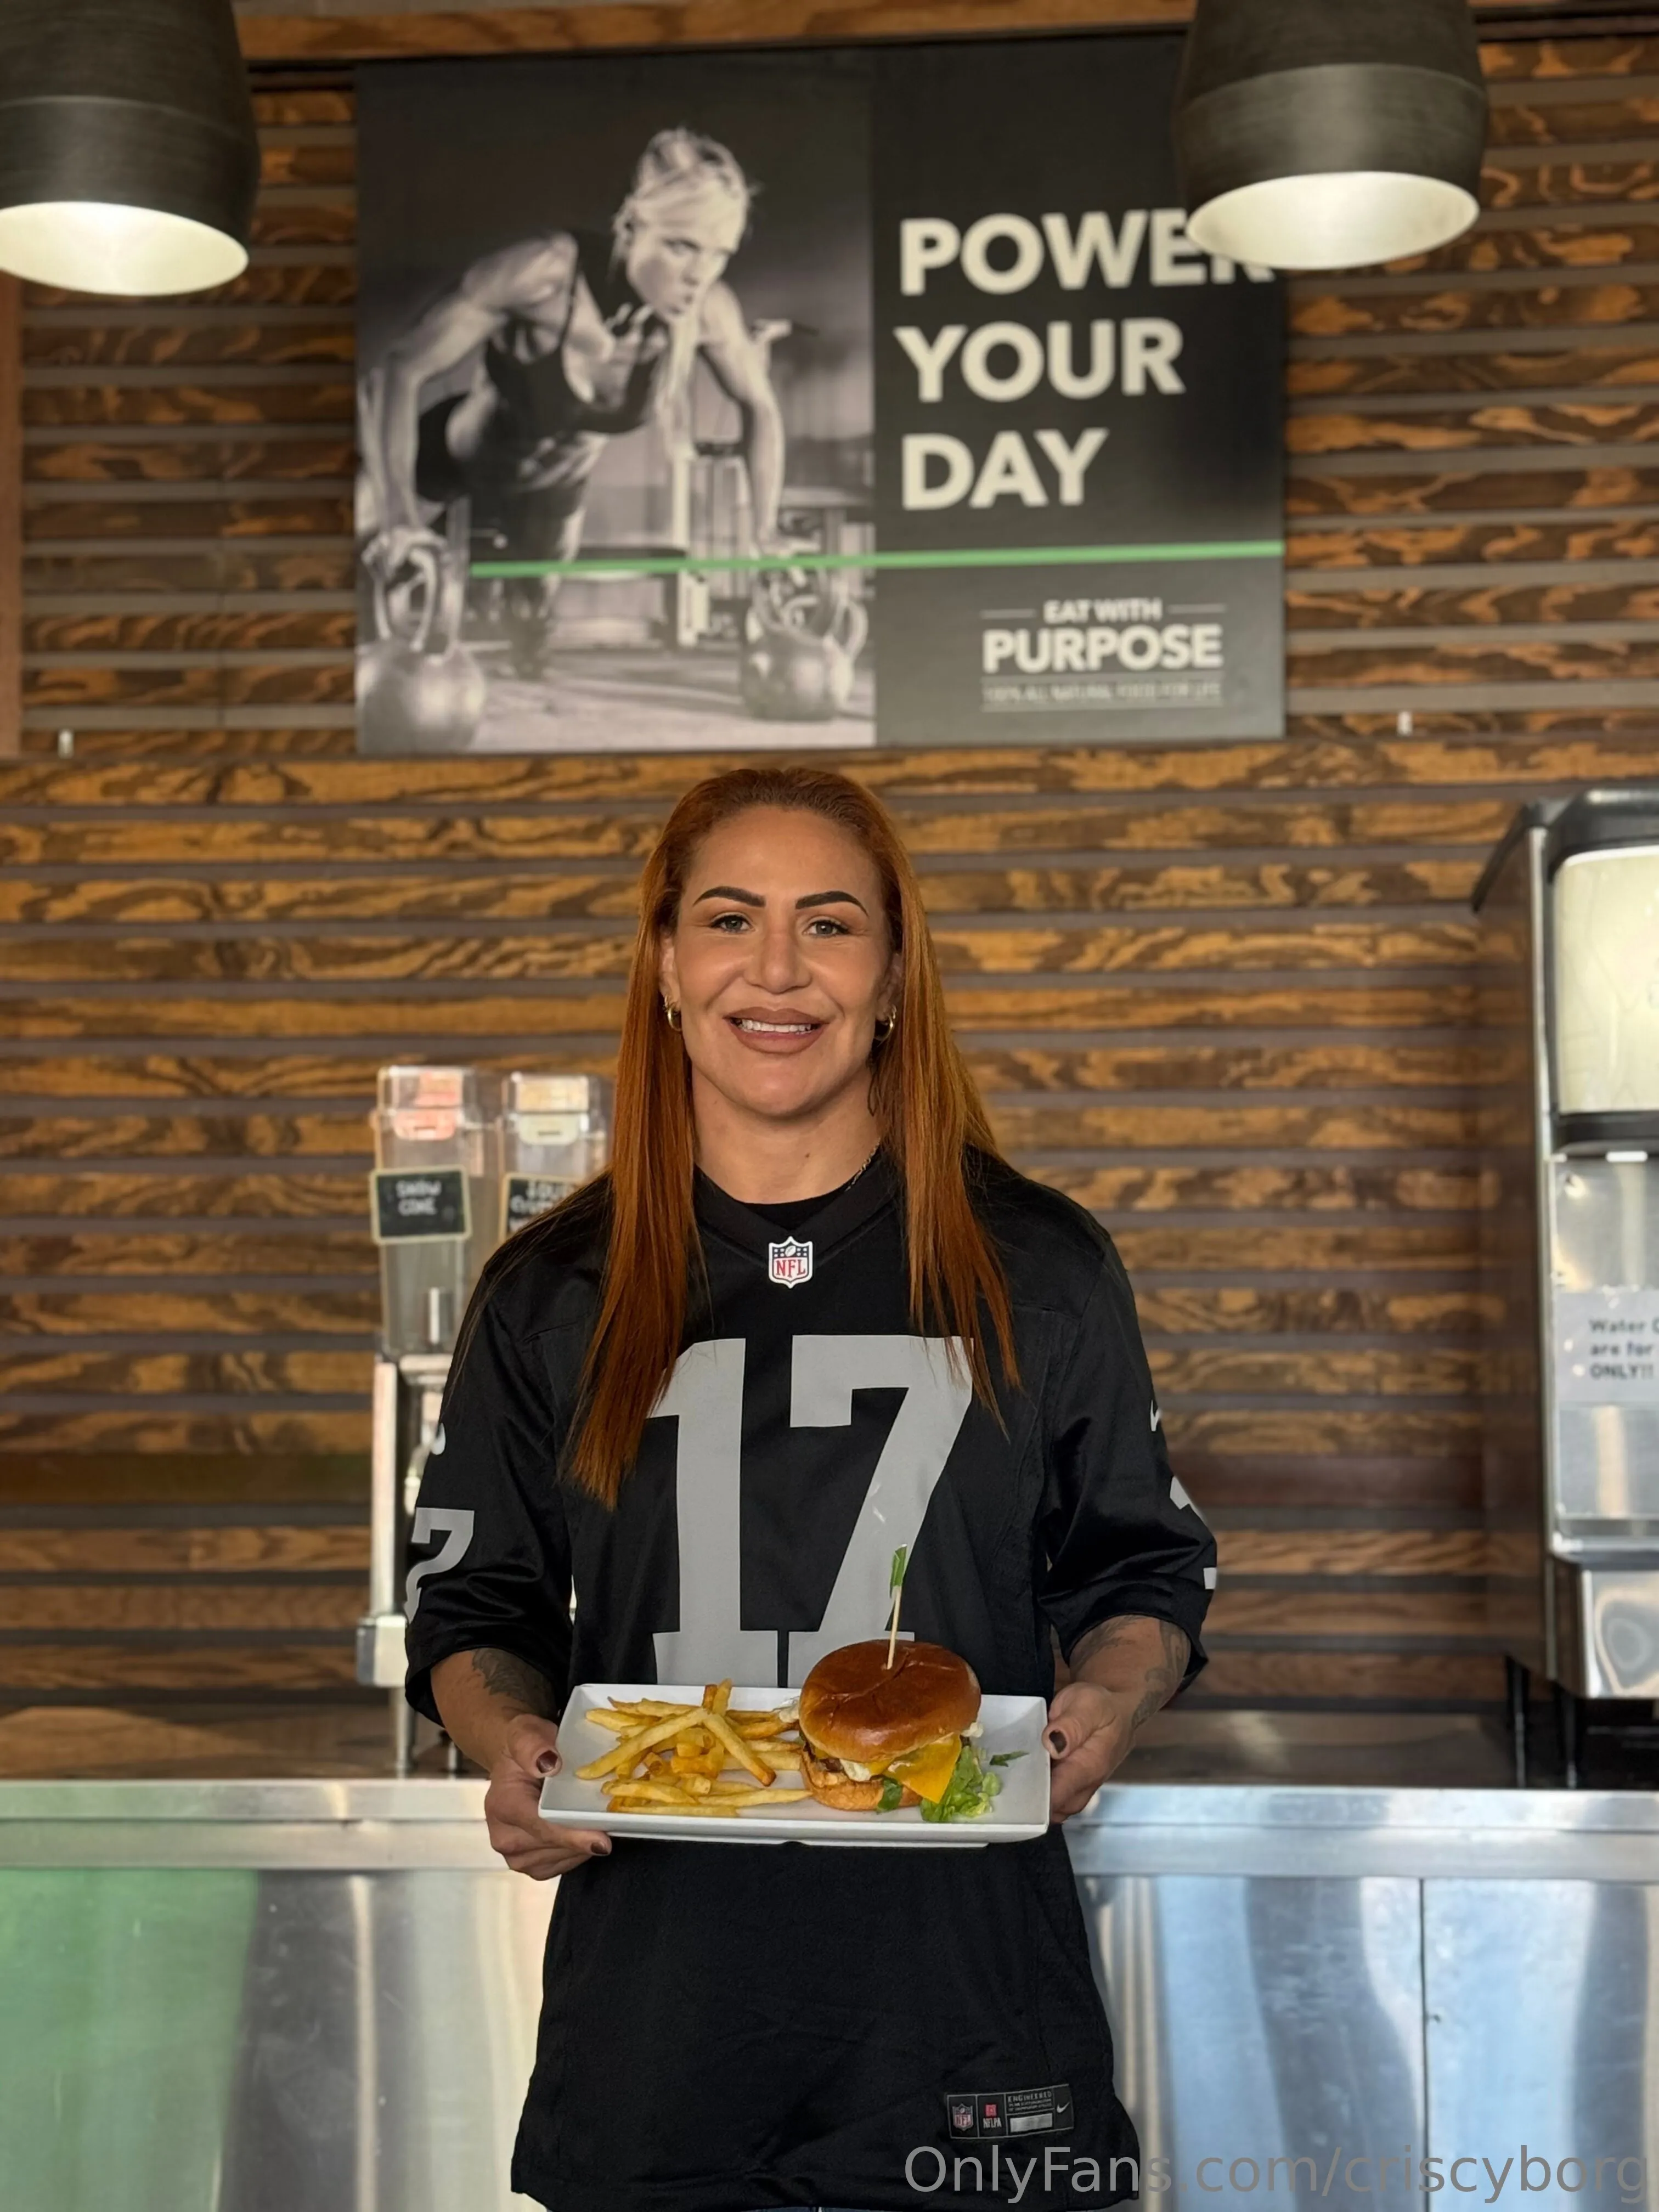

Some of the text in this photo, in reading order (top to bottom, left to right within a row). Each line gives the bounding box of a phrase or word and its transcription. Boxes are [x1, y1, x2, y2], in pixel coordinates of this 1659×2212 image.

[900, 208, 1275, 295] POWE
[894, 318, 1186, 402] YOUR
[902, 428, 1108, 510] DAY
[1044, 598, 1162, 623] EAT WITH
[983, 624, 1223, 673] PURPOSE
[776, 1259, 806, 1278] NFL
[1589, 1319, 1646, 1333] Water
[645, 1335, 974, 1688] 17
